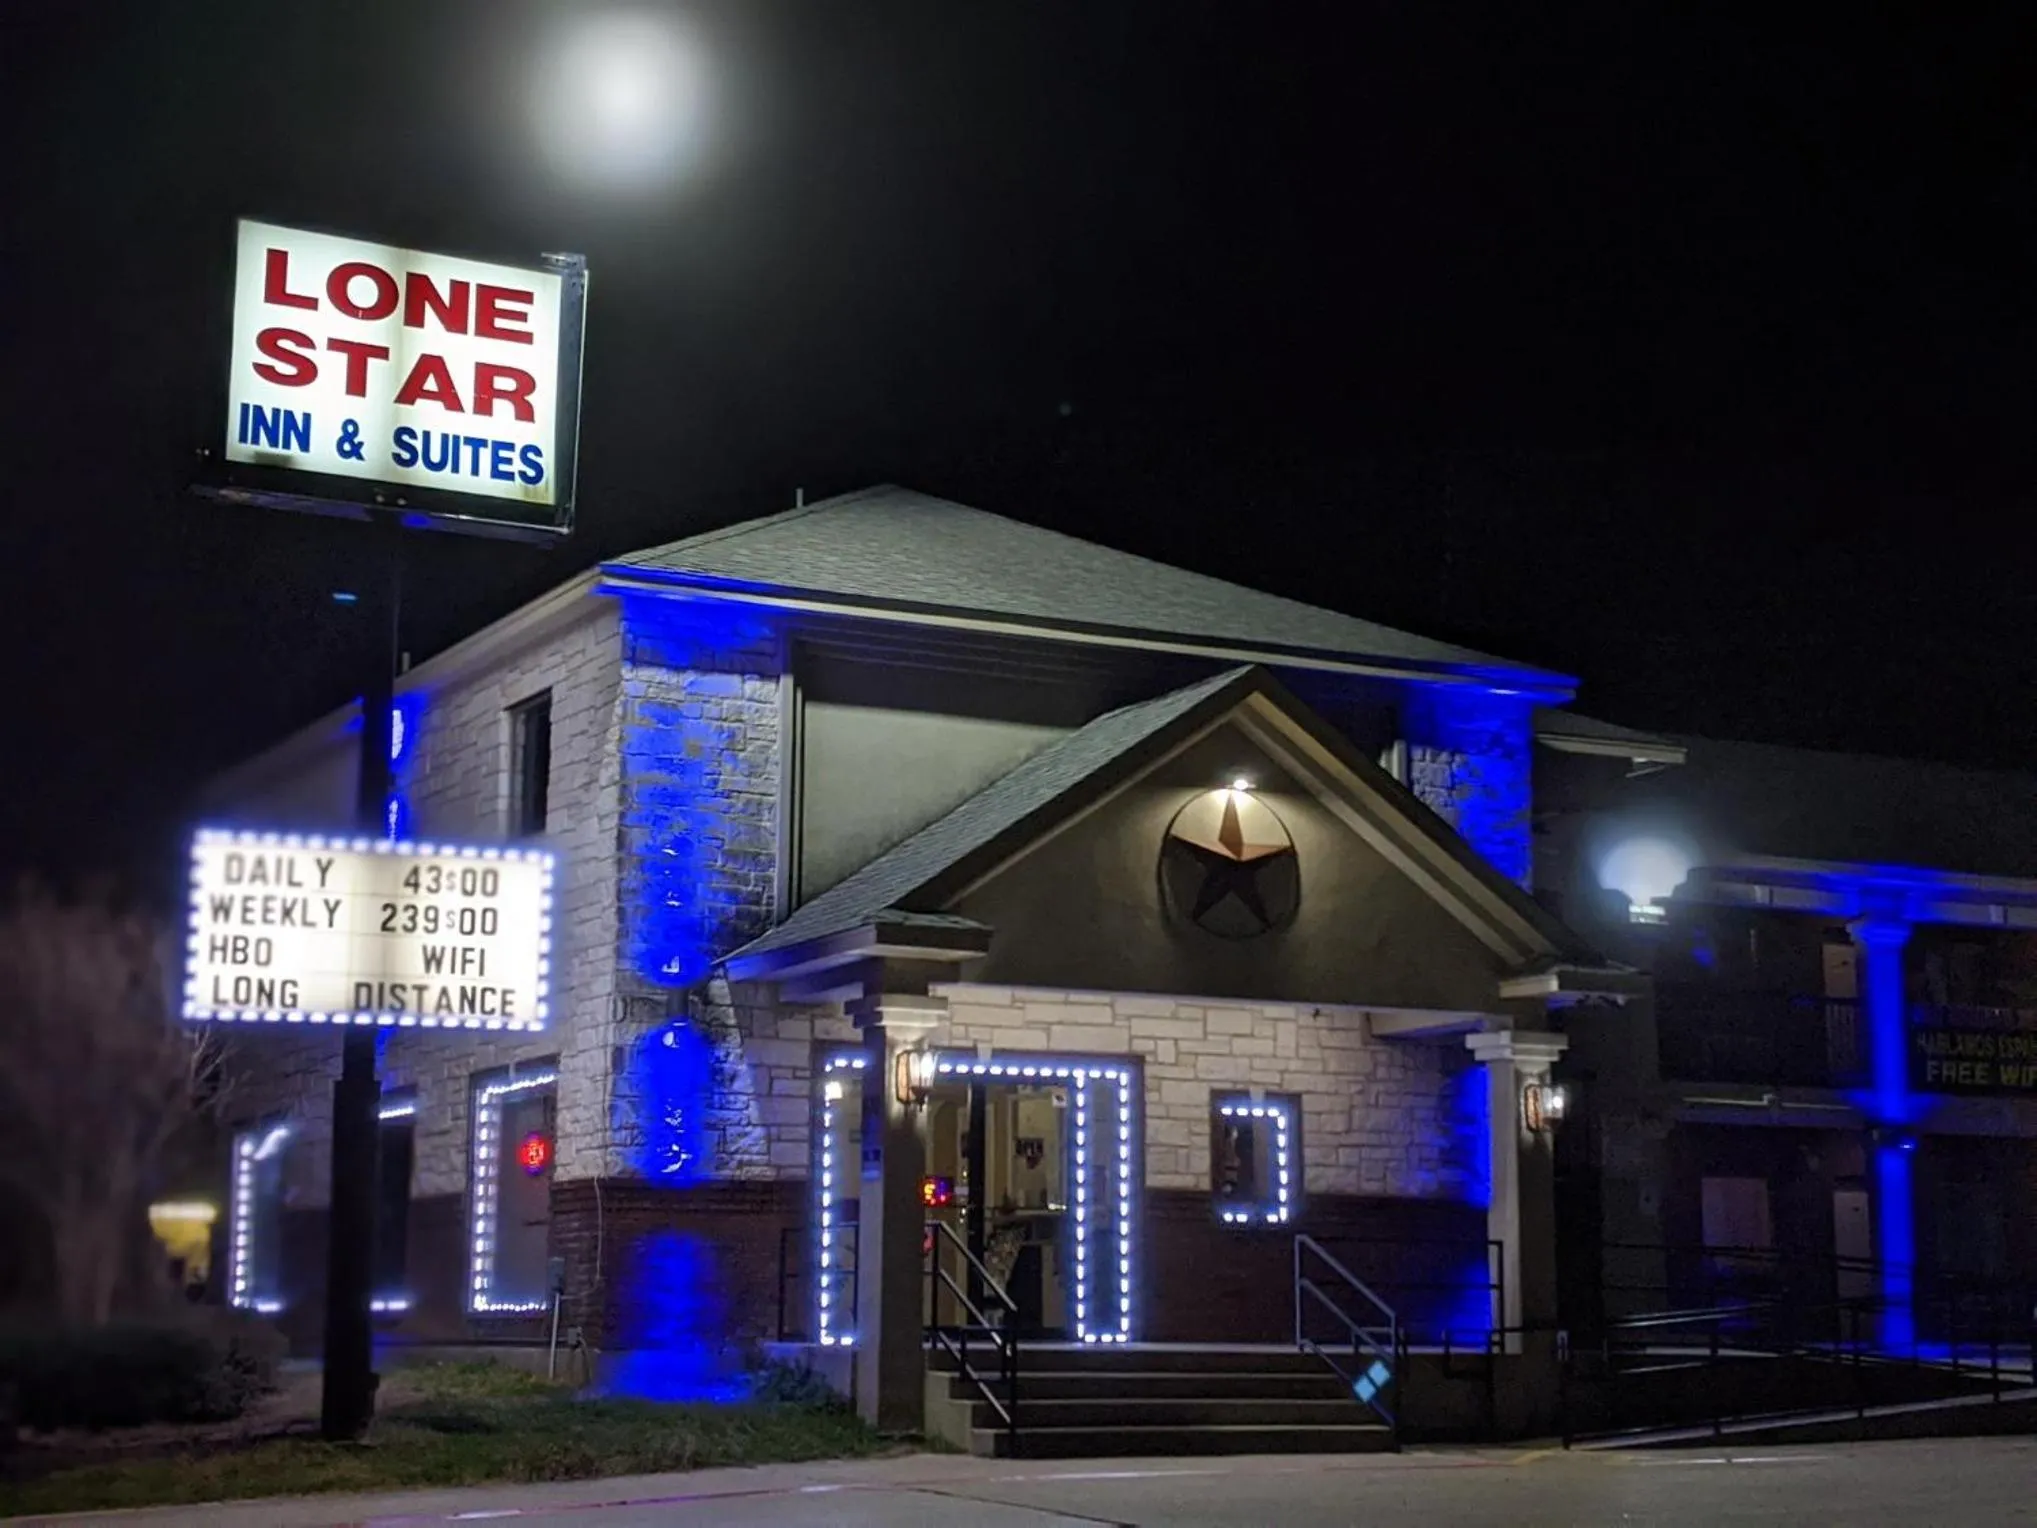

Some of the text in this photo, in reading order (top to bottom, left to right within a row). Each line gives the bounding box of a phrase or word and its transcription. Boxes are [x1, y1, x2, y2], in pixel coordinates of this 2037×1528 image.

[264, 249, 534, 345] LONE
[252, 327, 536, 424] STAR
[238, 403, 545, 486] INN & SUITES
[224, 853, 335, 889] DAILY
[208, 894, 342, 929] WEEKLY
[208, 934, 487, 977] HBO WIFI
[212, 976, 517, 1018] LONG DISTANCE
[1926, 1059, 1989, 1086] FREE
